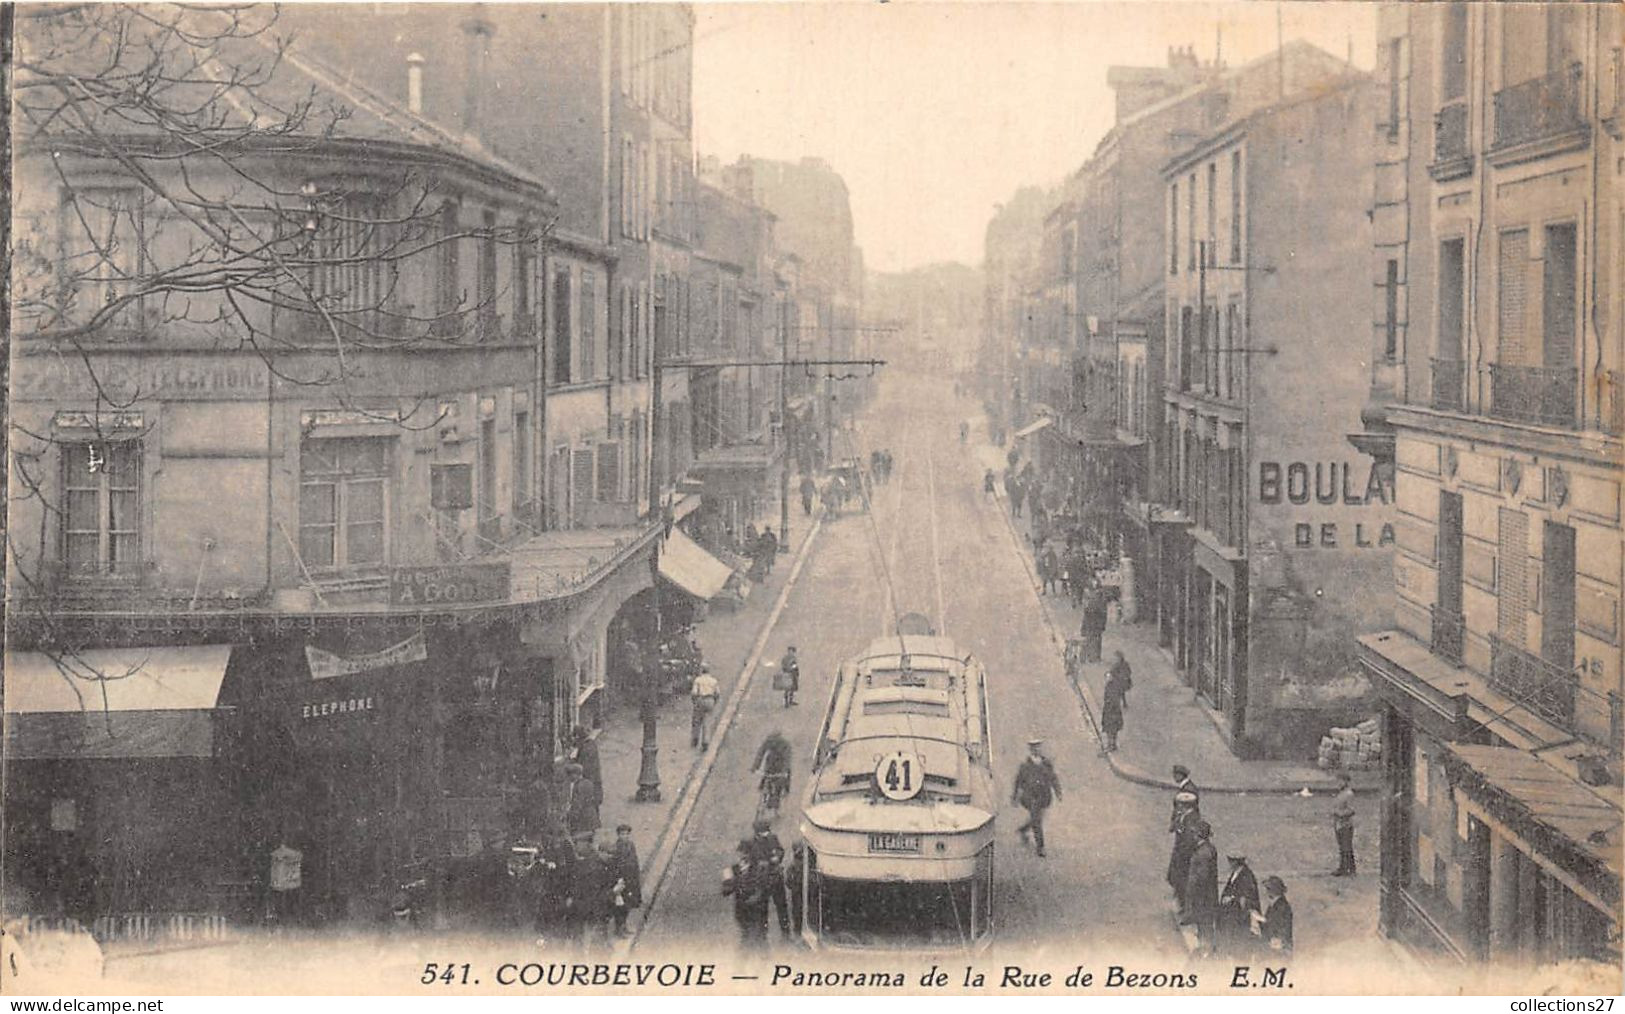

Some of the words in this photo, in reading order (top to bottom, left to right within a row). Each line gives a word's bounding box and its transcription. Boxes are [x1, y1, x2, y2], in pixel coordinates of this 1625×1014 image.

[1260, 461, 1396, 505] BOULA
[1295, 523, 1338, 548] DE
[1355, 523, 1396, 548] LA
[885, 760, 912, 791] 41
